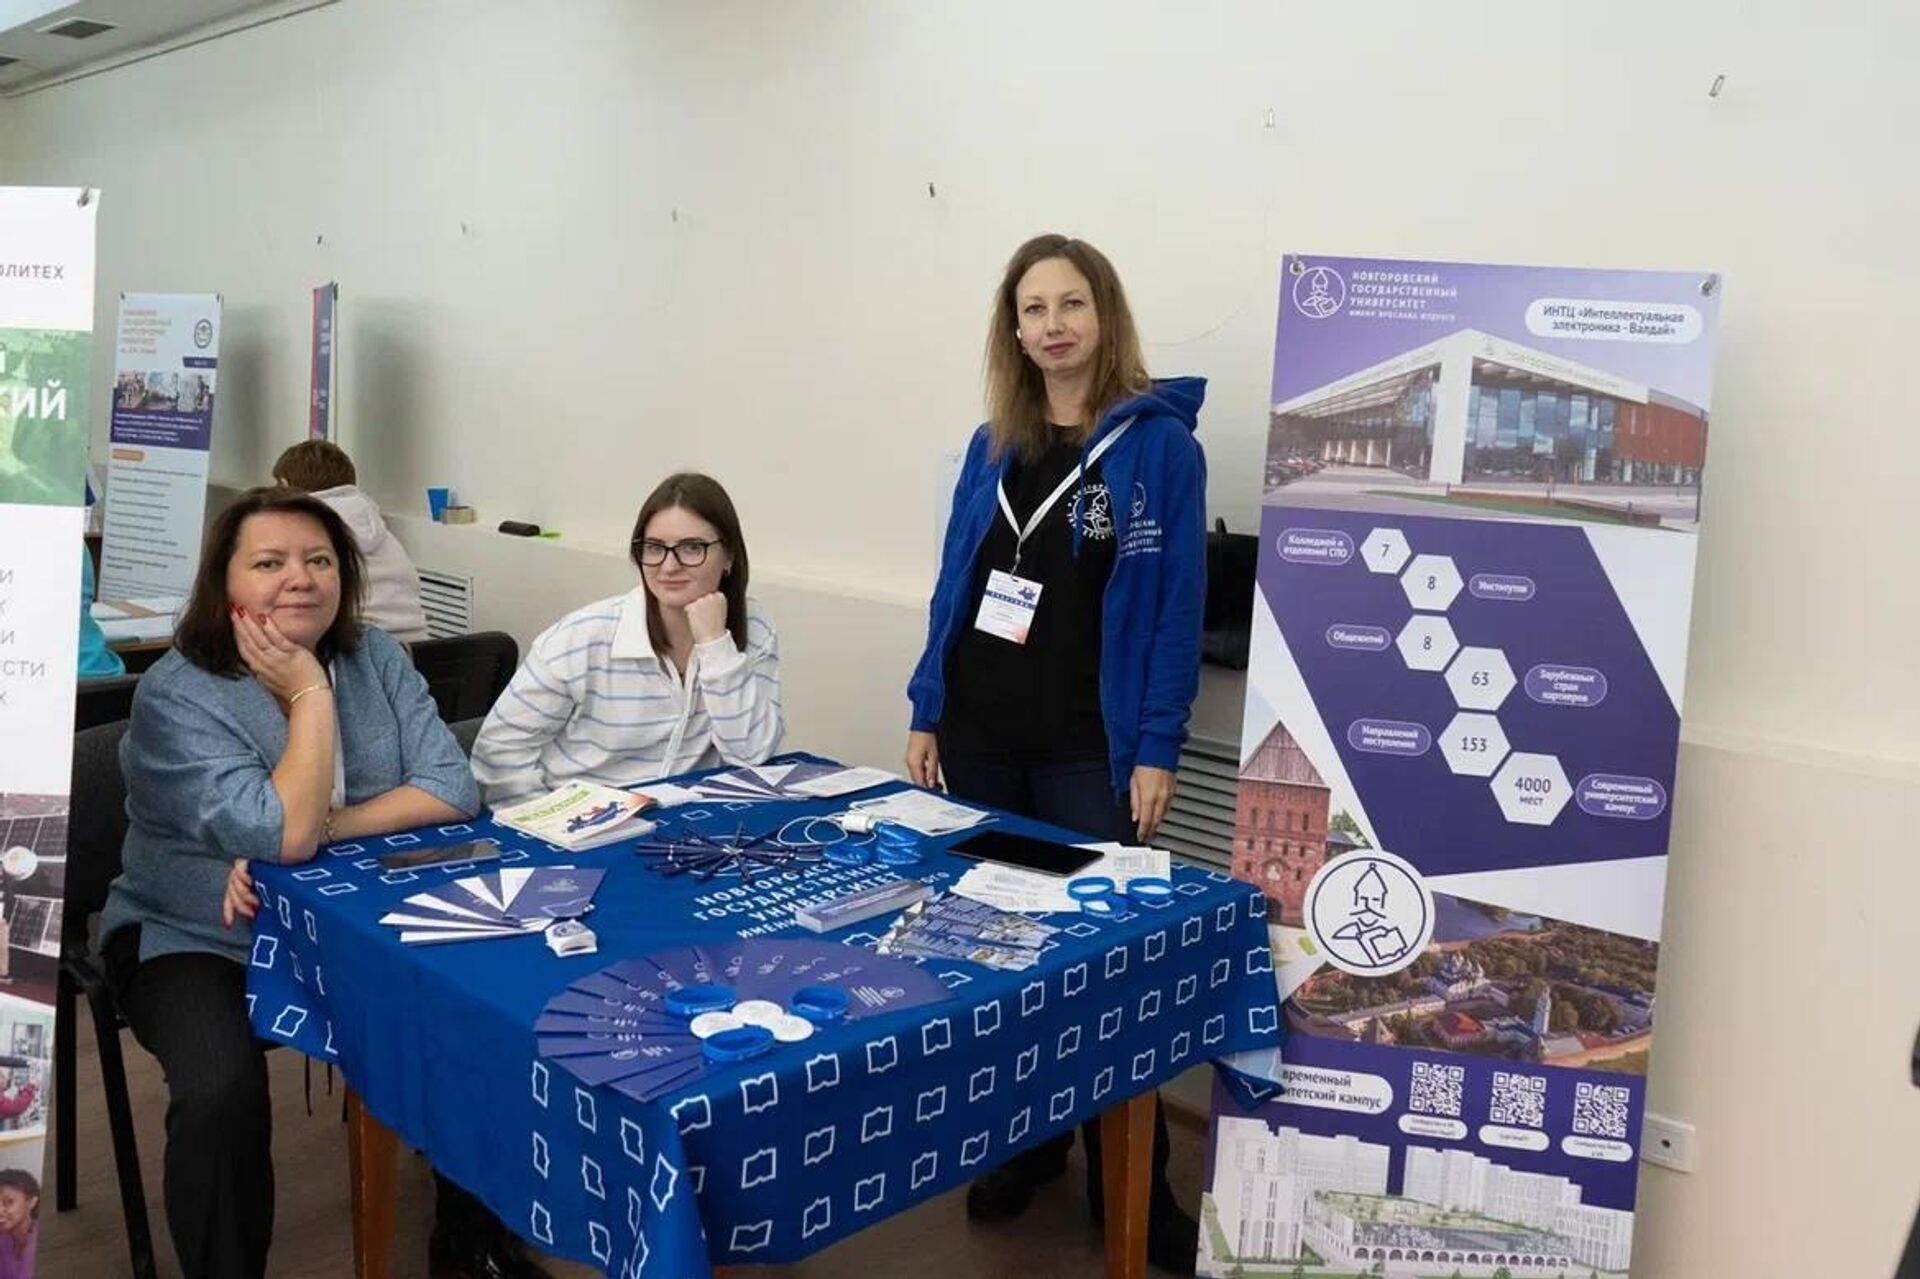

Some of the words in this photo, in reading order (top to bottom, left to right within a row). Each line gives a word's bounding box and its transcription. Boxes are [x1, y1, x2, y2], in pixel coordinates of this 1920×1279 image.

[1352, 271, 1438, 284] НОВГОРОДСКИЙ
[1351, 284, 1457, 297] ГОСУДАРСТВЕННЫЙ
[1350, 297, 1426, 309] УНИВЕРСИТЕТ
[1543, 305, 1576, 319] ИНТЦ
[1578, 307, 1685, 324] «Интеллектуальная
[1552, 322, 1621, 334] электроника
[1381, 544, 1390, 558] 7
[1427, 576, 1436, 590] 8
[1423, 636, 1432, 651] 8
[1471, 671, 1489, 686] 63
[1461, 736, 1488, 752] 153
[1514, 777, 1552, 793] 4000
[694, 862, 842, 906] НОВГОРОДСК
[748, 872, 903, 922] УНИВЕРСИТЕТ
[1282, 1070, 1352, 1087] временный
[1338, 1094, 1382, 1110] кампус
